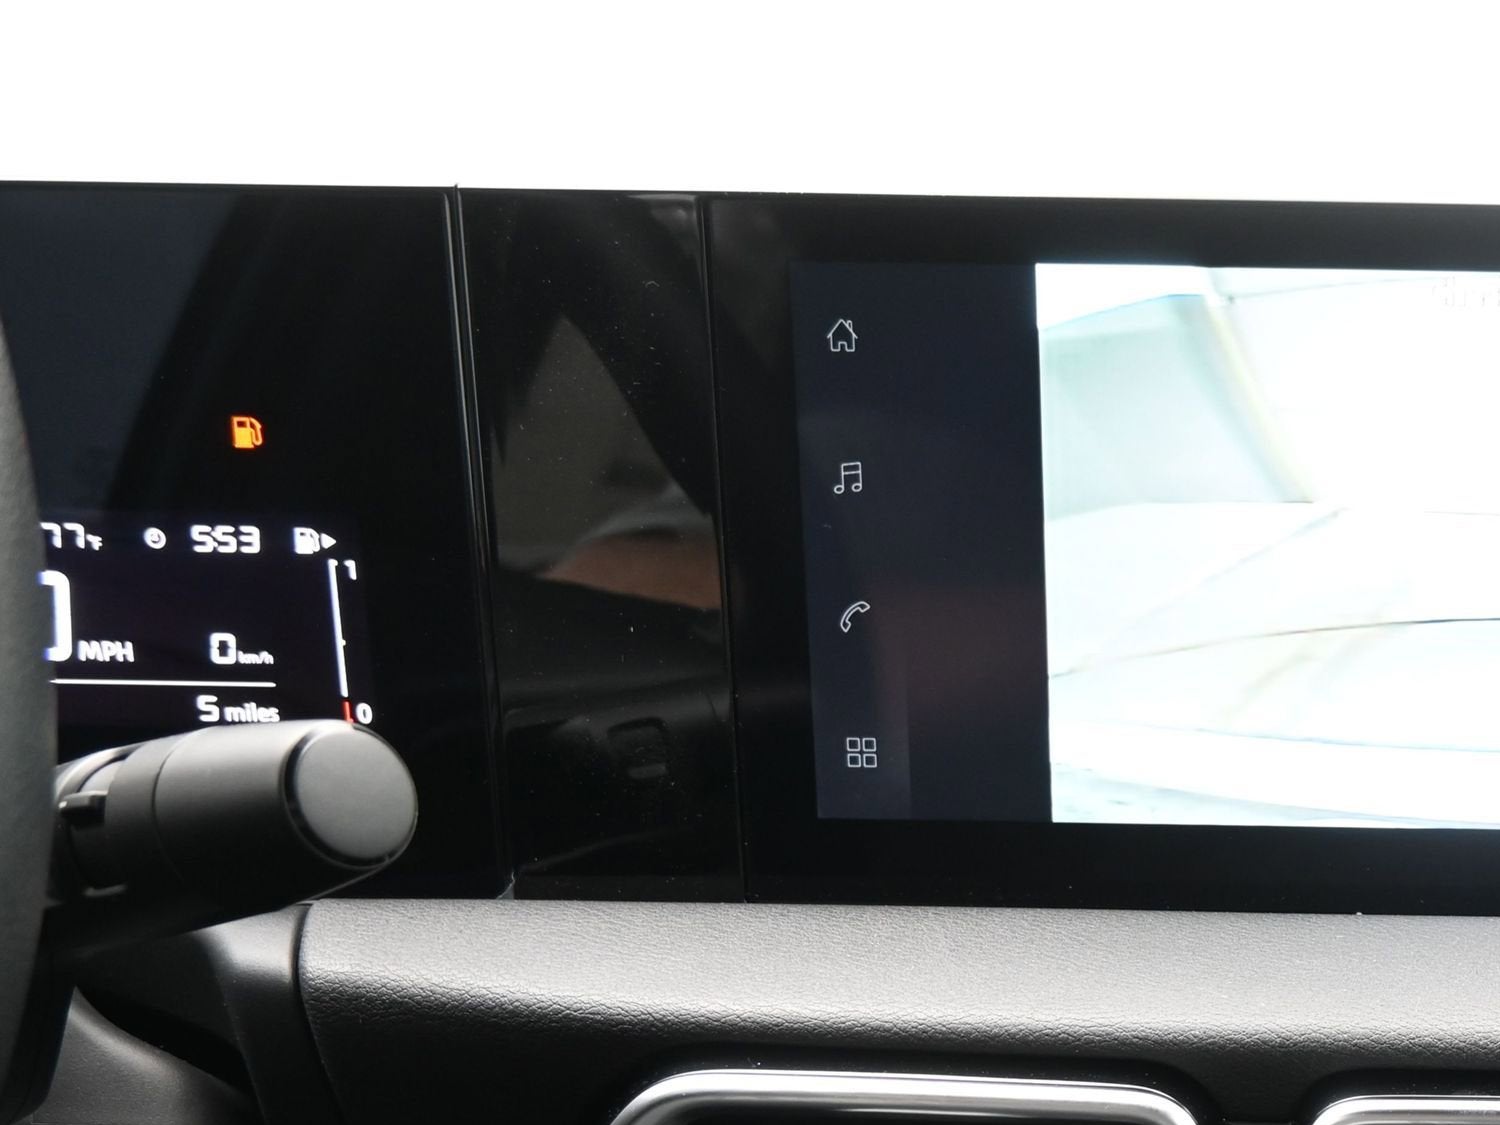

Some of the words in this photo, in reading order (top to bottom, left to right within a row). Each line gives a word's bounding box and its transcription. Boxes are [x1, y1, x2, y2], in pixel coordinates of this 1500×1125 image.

[344, 560, 356, 580] 1
[77, 640, 134, 662] MPH
[209, 633, 236, 664] 0
[238, 651, 274, 664] km/h
[196, 695, 219, 722] 5
[223, 702, 280, 722] miles
